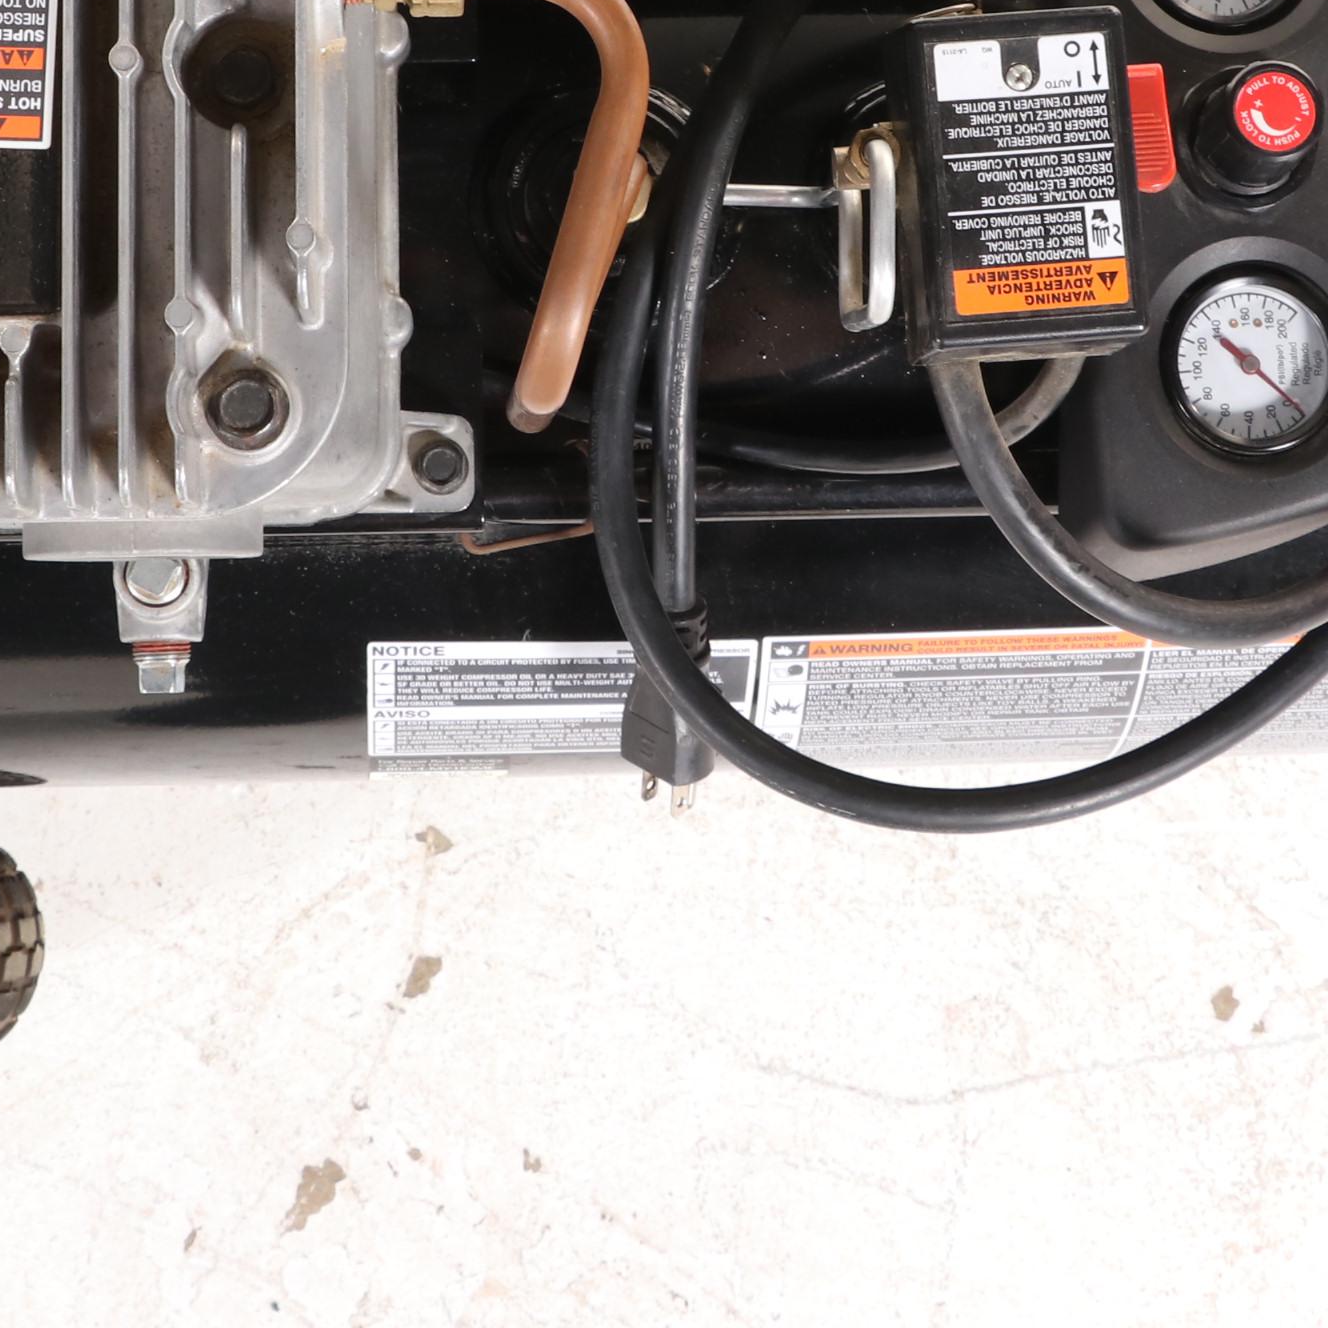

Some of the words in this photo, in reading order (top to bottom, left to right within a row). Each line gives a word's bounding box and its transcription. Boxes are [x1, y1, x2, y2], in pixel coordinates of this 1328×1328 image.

[1044, 79, 1072, 89] AUTO
[1074, 93, 1106, 105] AVANT
[1246, 77, 1269, 95] PULL
[1272, 76, 1285, 85] TO
[1286, 82, 1310, 116] ADJUST
[8, 96, 42, 110] HOT
[952, 101, 996, 114] BOITIER.
[997, 100, 1011, 111] LE
[1013, 96, 1070, 110] D'ENLEVER
[970, 112, 1018, 125] MACHINE
[1020, 111, 1034, 123] LA
[1036, 105, 1108, 121] DEBRANCHEZ
[1015, 123, 1046, 135] CHOC
[1048, 121, 1062, 132] DE
[1065, 117, 1109, 131] DANGER
[1240, 111, 1257, 137] LOCK
[945, 125, 1012, 139] ELECTRIQUE.
[1063, 129, 1110, 143] VOLTAGE
[1274, 130, 1300, 145] PUSH
[993, 132, 1061, 147] DANGEREUX.
[1259, 134, 1271, 144] TO
[1020, 155, 1059, 167] QUITAR
[1061, 153, 1075, 165] DE
[1077, 150, 1112, 163] ANTES
[948, 159, 1003, 172] CUBIERTA.
[1004, 158, 1018, 169] LA
[1036, 162, 1113, 178] DESCONECTAR
[977, 170, 1018, 183] UNIDAD
[1019, 168, 1033, 179] LA
[1069, 174, 1114, 188] CHOQUE
[997, 193, 1037, 205] RIESGO
[1039, 189, 1087, 202] VOLTAJE.
[1089, 186, 1116, 199] ALTO
[981, 195, 996, 207] DE
[952, 217, 989, 230] COVER.
[990, 213, 1041, 227] REMOVING
[1043, 211, 1082, 224] BEFORE
[980, 228, 1002, 240] UNIT
[1004, 226, 1044, 239] UNPLUG
[1046, 223, 1084, 236] SHOCK.
[986, 239, 1044, 252] ELECTRICAL
[1046, 237, 1060, 248] OF
[1062, 235, 1085, 247] RISK
[978, 252, 1024, 265] VOLTAGE.
[1025, 247, 1086, 262] HAZARDOUS
[966, 264, 1093, 284] AVERTISSEMENT
[986, 277, 1094, 295] ADVERTENCIA
[1024, 290, 1096, 306] WARNING
[1240, 307, 1250, 327] 160
[1264, 310, 1274, 329] 180
[1211, 319, 1223, 340] 140
[1277, 319, 1288, 339] 200
[1197, 337, 1207, 357] 120
[1192, 361, 1202, 380] 100
[1291, 342, 1299, 386] Regulated
[1302, 343, 1311, 385] Regulado
[1203, 386, 1212, 400] 80
[1220, 403, 1231, 417] 60
[1266, 404, 1276, 418] 20
[1244, 410, 1254, 424] 40
[372, 646, 445, 656] NOTICE
[830, 643, 913, 654] WARNING
[374, 710, 431, 718] AVISO
